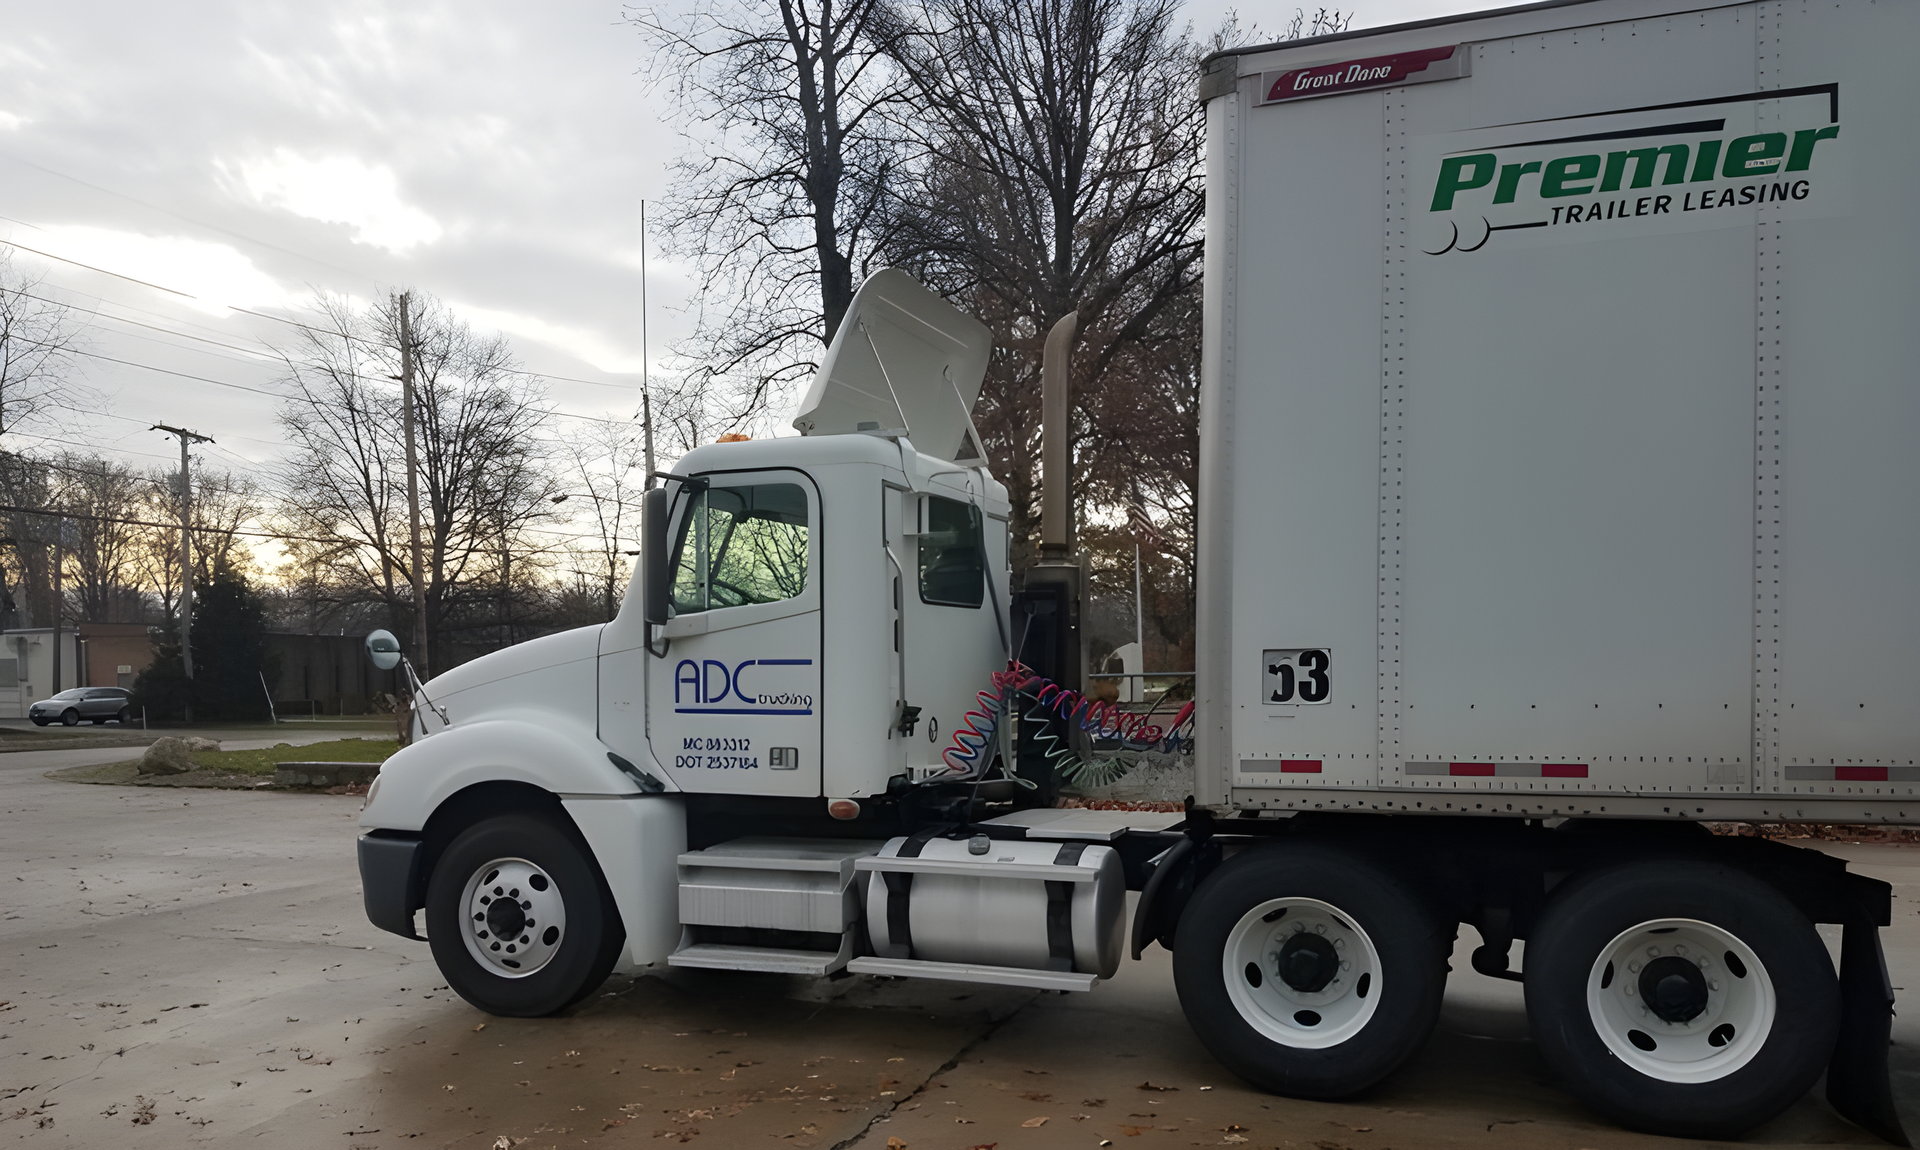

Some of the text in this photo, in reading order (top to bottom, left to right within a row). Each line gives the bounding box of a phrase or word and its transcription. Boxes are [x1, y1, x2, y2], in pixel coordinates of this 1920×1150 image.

[1429, 125, 1841, 213] Premier
[1551, 179, 1811, 226] TRAILER LEASING
[674, 659, 757, 704] ADC
[675, 755, 703, 769] DOT
